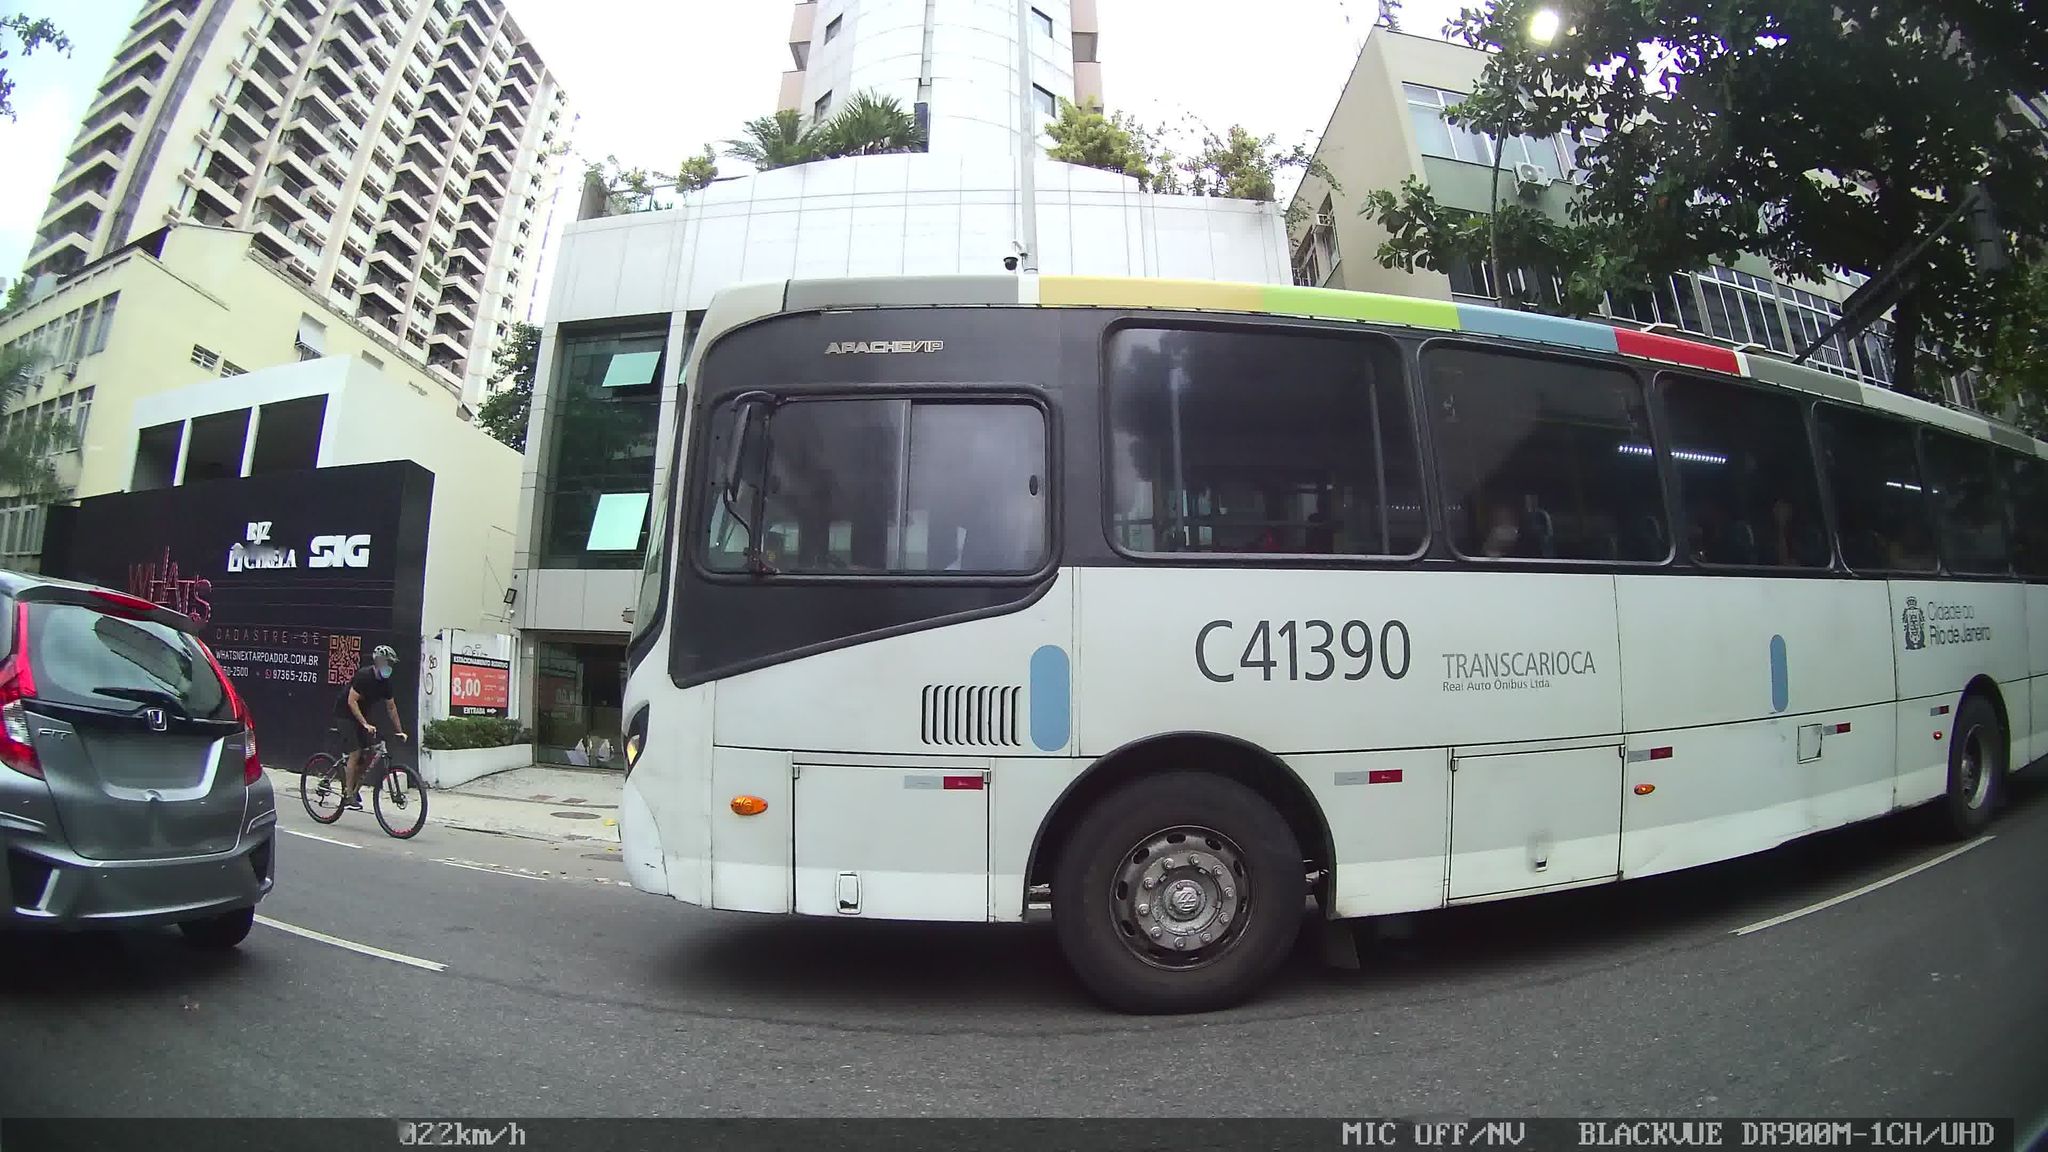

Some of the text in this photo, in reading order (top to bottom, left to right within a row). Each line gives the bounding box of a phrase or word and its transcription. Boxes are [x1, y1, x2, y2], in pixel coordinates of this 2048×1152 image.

[246, 521, 272, 545] RJZ
[308, 534, 371, 568] SIG
[1195, 619, 1411, 683] C41390
[272, 669, 318, 683] 97365-2676
[1442, 651, 1596, 679] TRANSCARIOCA
[453, 677, 481, 699] 8,00
[1442, 681, 1464, 692] Real
[1467, 681, 1492, 691] Auto
